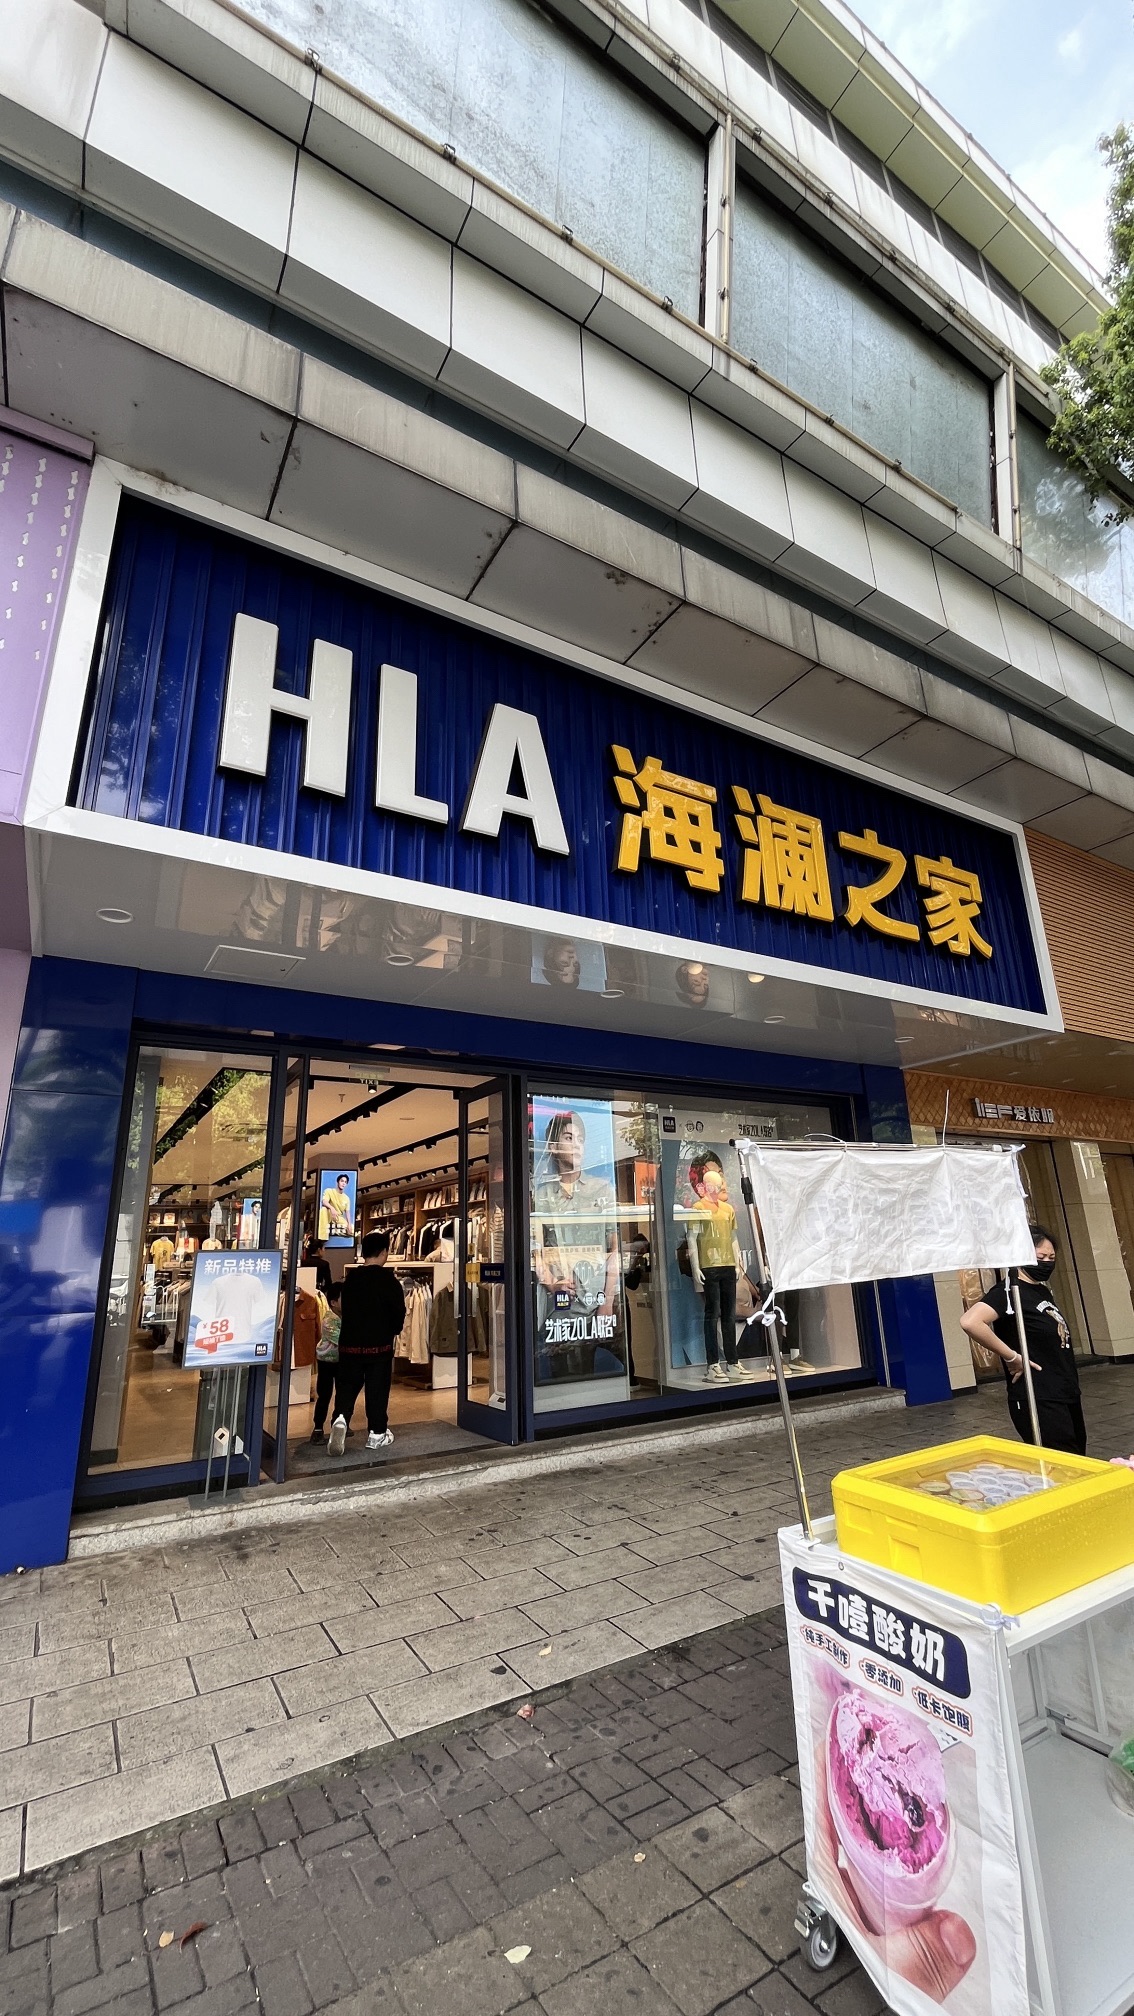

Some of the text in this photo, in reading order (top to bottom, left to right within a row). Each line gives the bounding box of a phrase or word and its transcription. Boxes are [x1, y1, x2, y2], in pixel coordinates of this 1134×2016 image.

[218, 611, 993, 958] HLA 海澜之家
[203, 1258, 271, 1275] 新品特推
[556, 1294, 570, 1302] HLA
[804, 1627, 970, 1731] 纯手工制作 零添加 低卡饱腹
